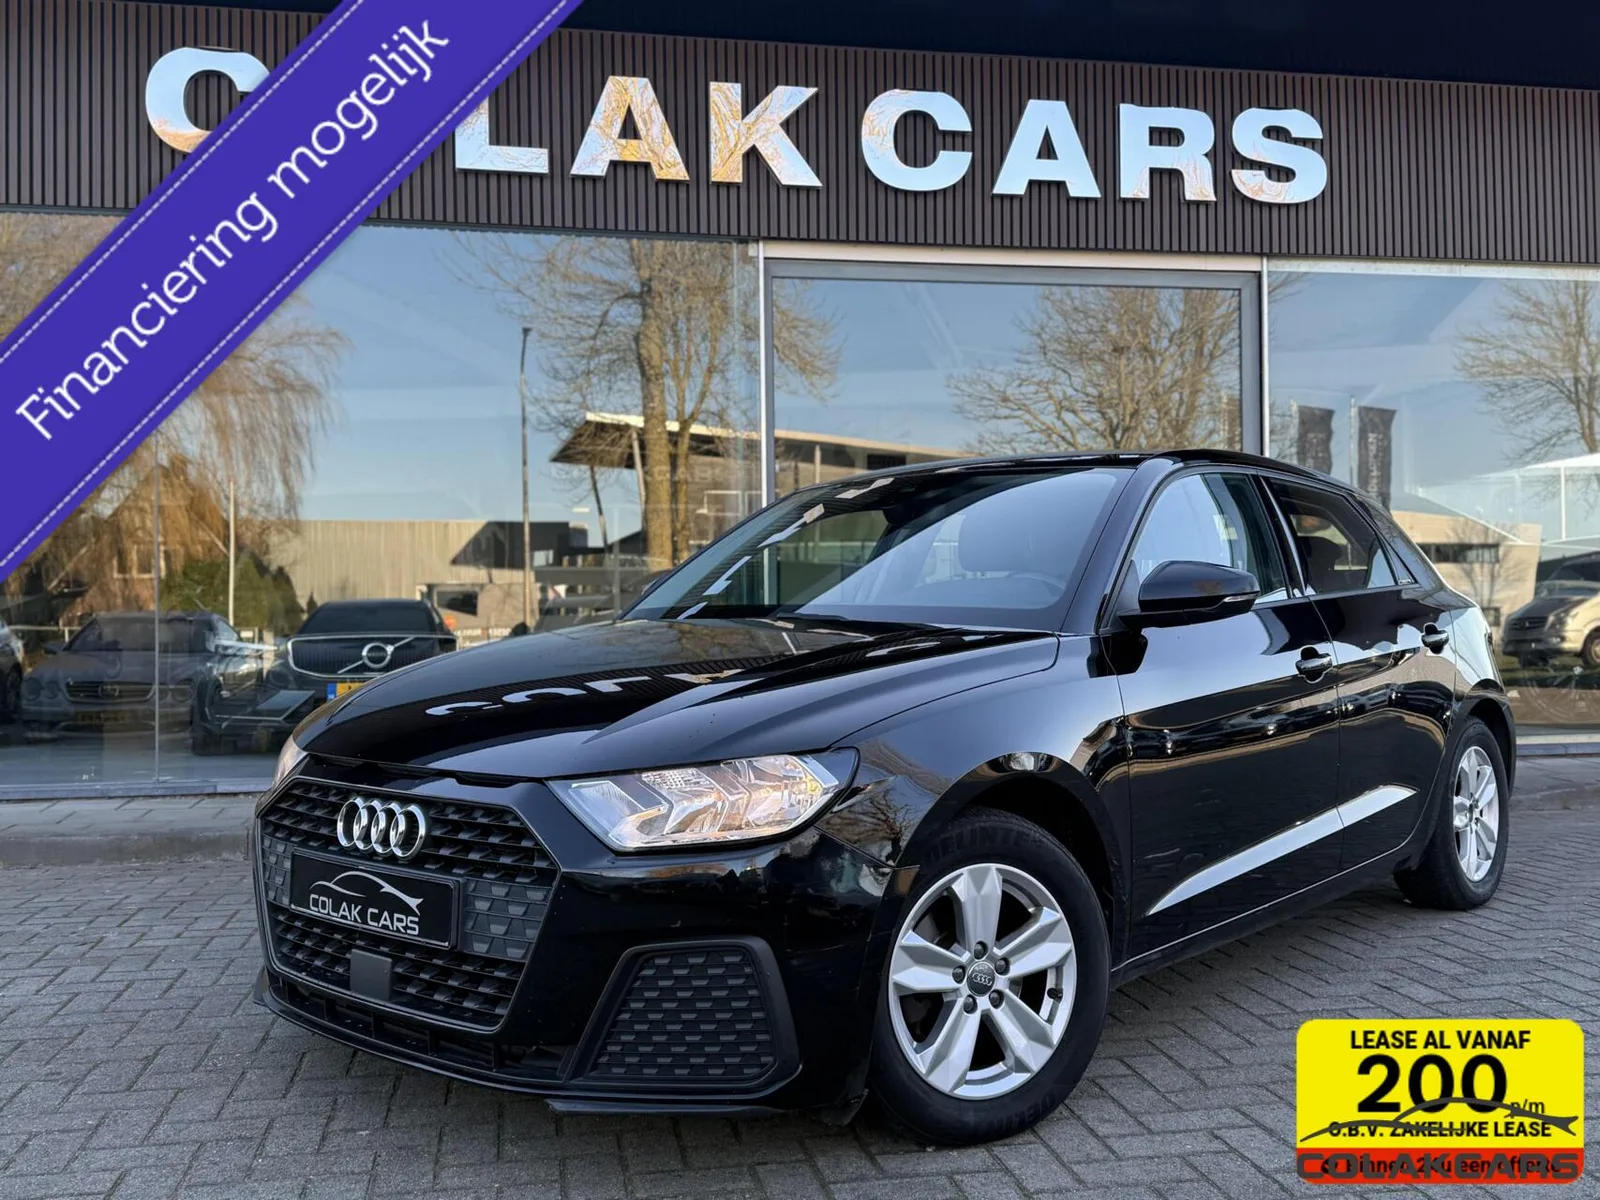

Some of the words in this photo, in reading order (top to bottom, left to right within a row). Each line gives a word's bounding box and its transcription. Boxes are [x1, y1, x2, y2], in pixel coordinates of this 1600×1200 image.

[145, 46, 822, 187] CLAK
[860, 88, 1327, 204] CARS
[309, 894, 362, 923] COLAK
[367, 908, 419, 936] CARS
